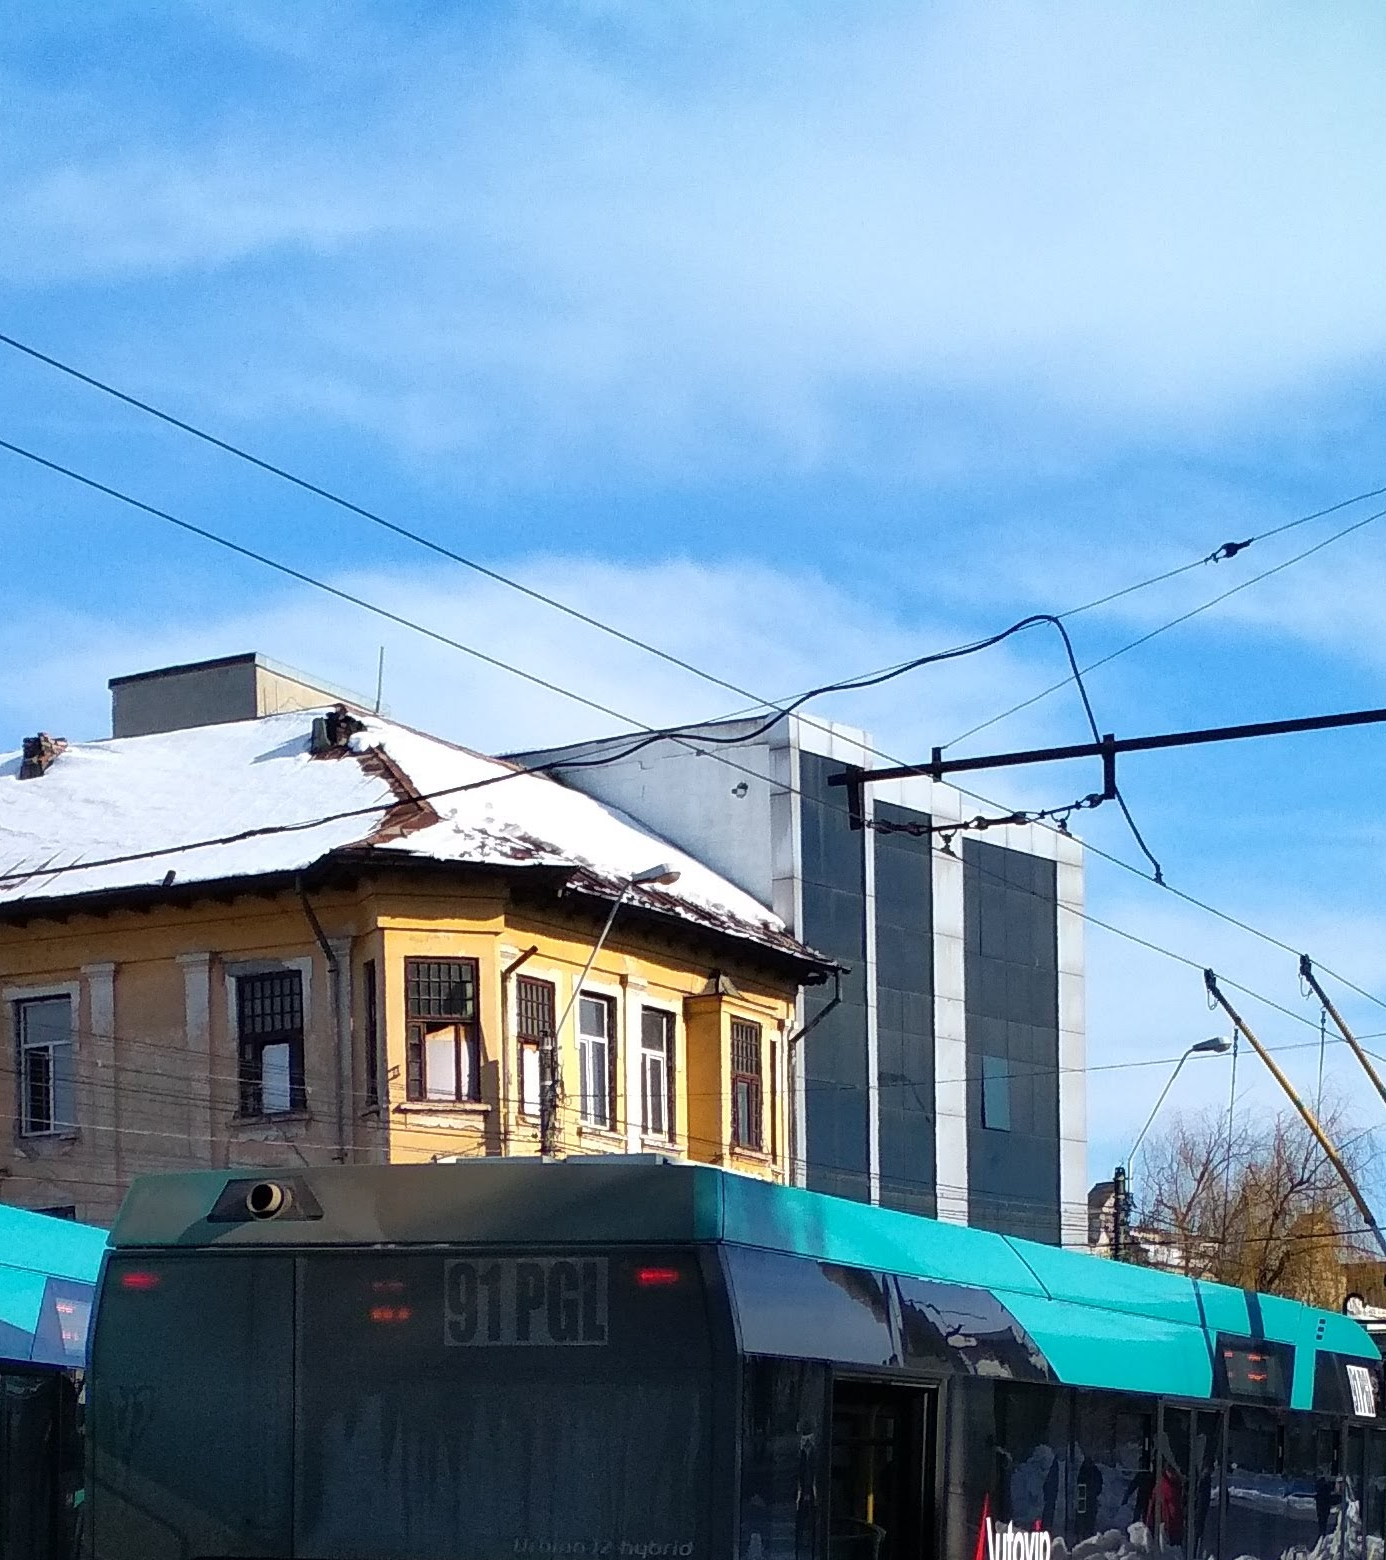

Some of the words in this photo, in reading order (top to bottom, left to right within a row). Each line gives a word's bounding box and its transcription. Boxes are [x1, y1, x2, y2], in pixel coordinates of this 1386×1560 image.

[447, 1261, 502, 1343] 91
[515, 1260, 606, 1343] PGL
[619, 1539, 694, 1559] hybrid
